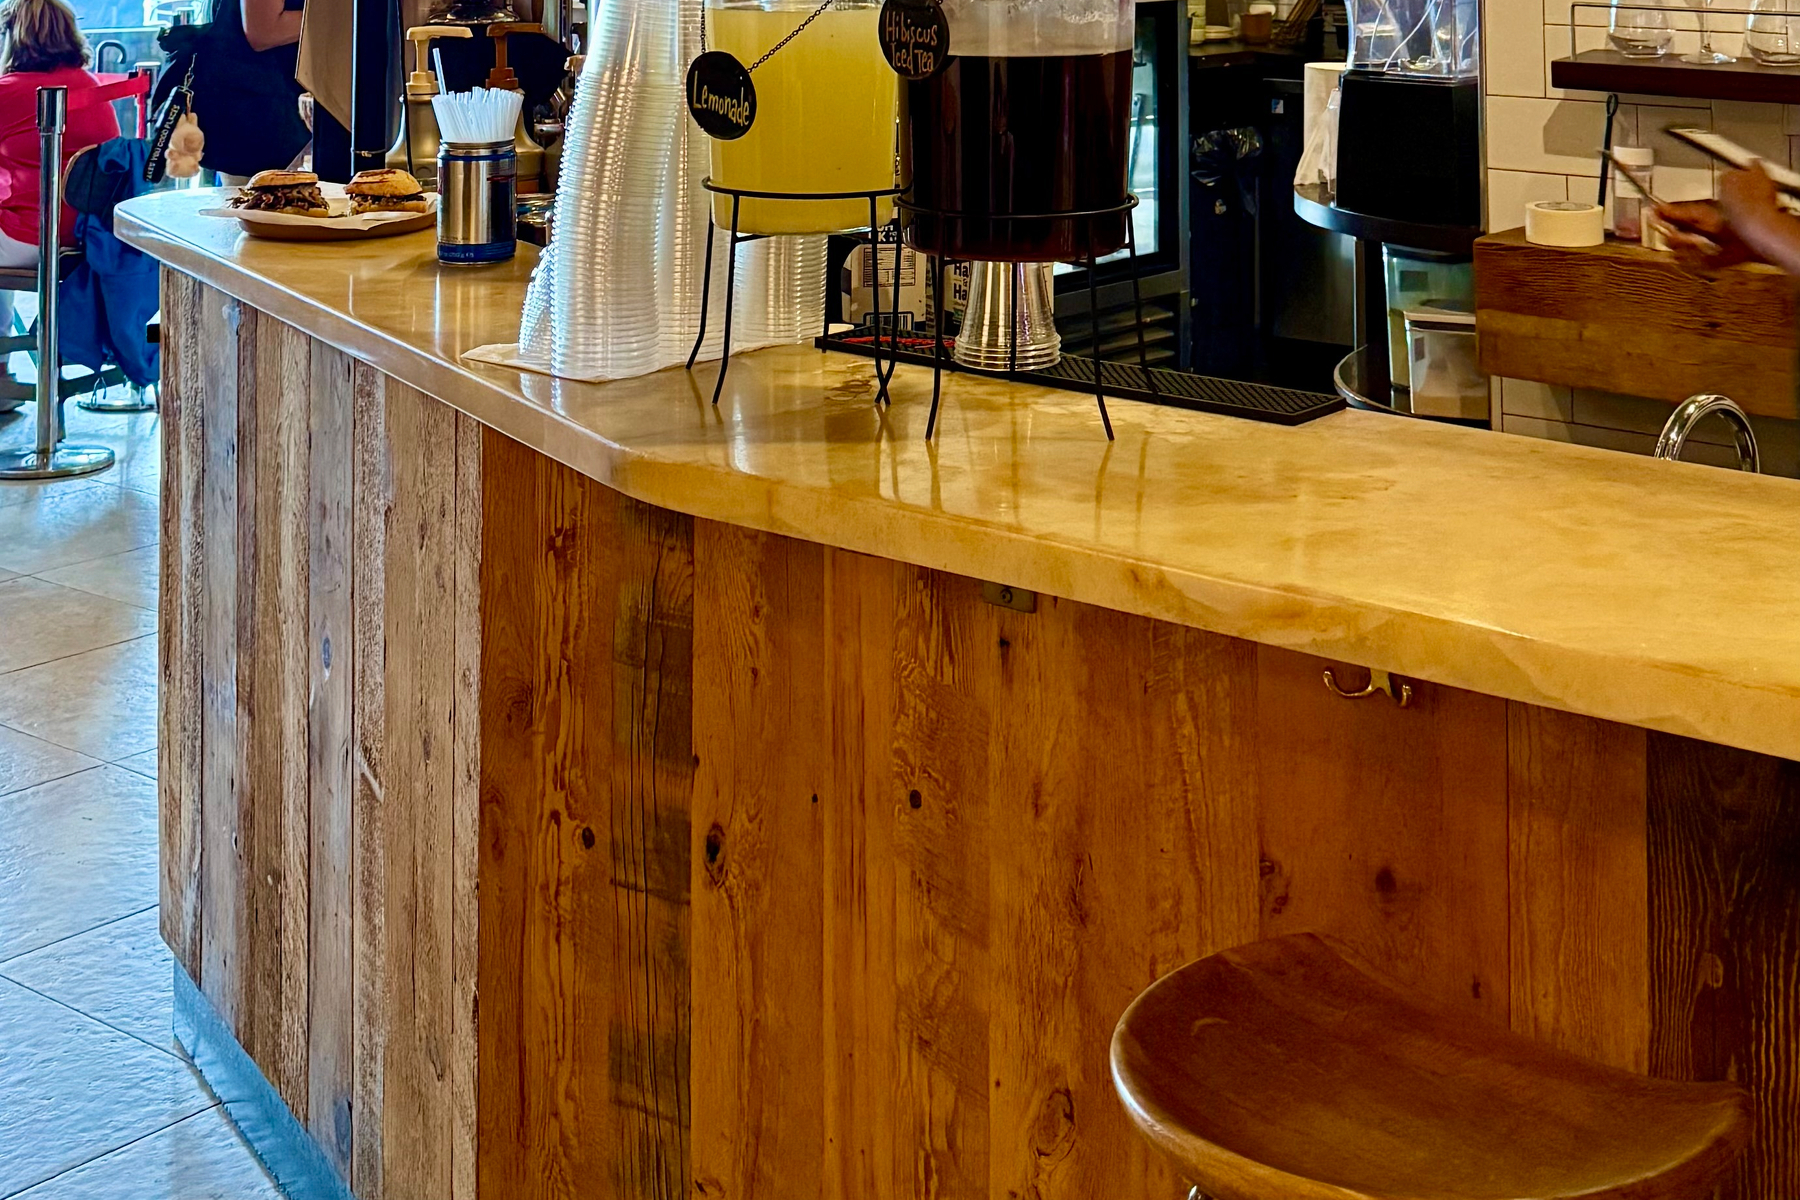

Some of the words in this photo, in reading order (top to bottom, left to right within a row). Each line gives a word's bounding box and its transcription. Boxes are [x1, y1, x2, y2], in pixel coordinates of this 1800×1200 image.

[885, 9, 938, 46] Hibiscus
[891, 41, 915, 75] Iced
[914, 48, 935, 73] Tea
[692, 70, 751, 127] Lemonade
